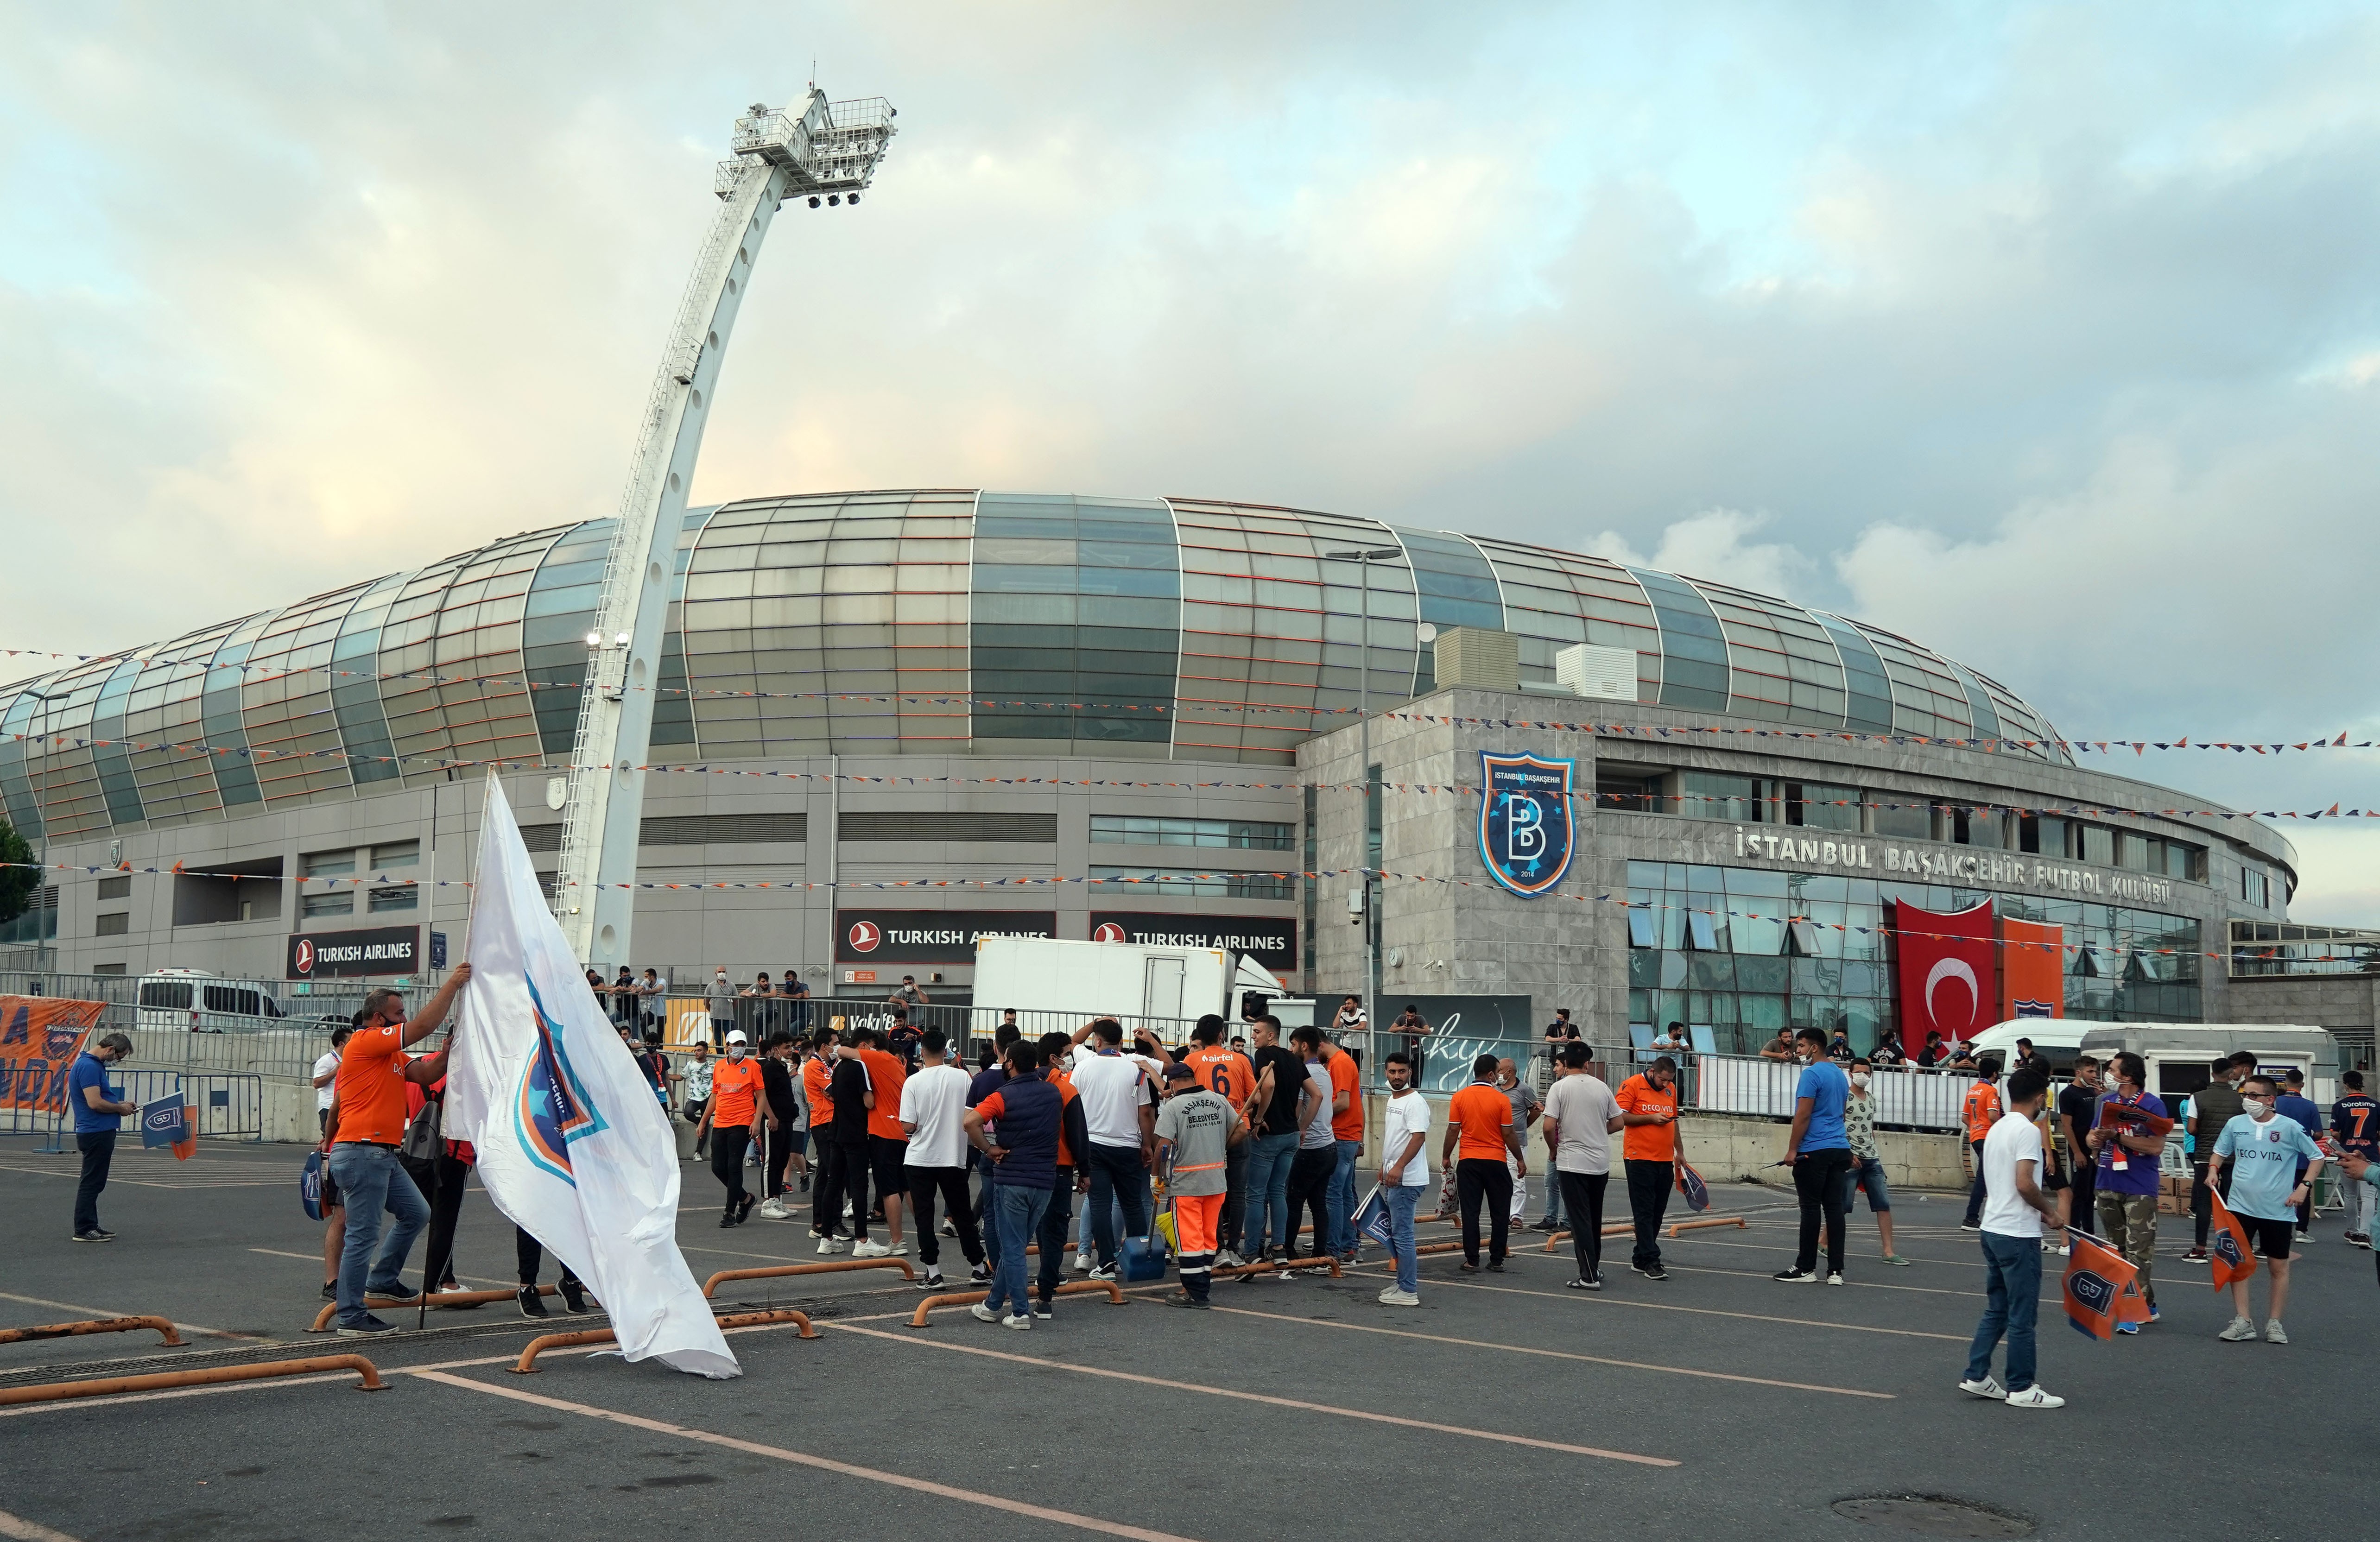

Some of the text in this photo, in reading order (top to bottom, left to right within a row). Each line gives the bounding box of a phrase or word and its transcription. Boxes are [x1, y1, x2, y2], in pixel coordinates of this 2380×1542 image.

[1525, 774, 1560, 784] BAŞAKŞEHİR
[1734, 826, 2169, 905] İSTANBUL BAŞAKŞEHİR FUTBOL KULÜBÜ
[888, 930, 963, 944] TURKISH
[1133, 933, 1285, 950] TURKISH AIRLINES
[317, 942, 411, 962] TURKISH AIRLINES
[1209, 1054, 1234, 1062] airfel
[1212, 1063, 1230, 1098] 6
[2350, 1108, 2369, 1138] 7
[2260, 1151, 2282, 1162] VITA
